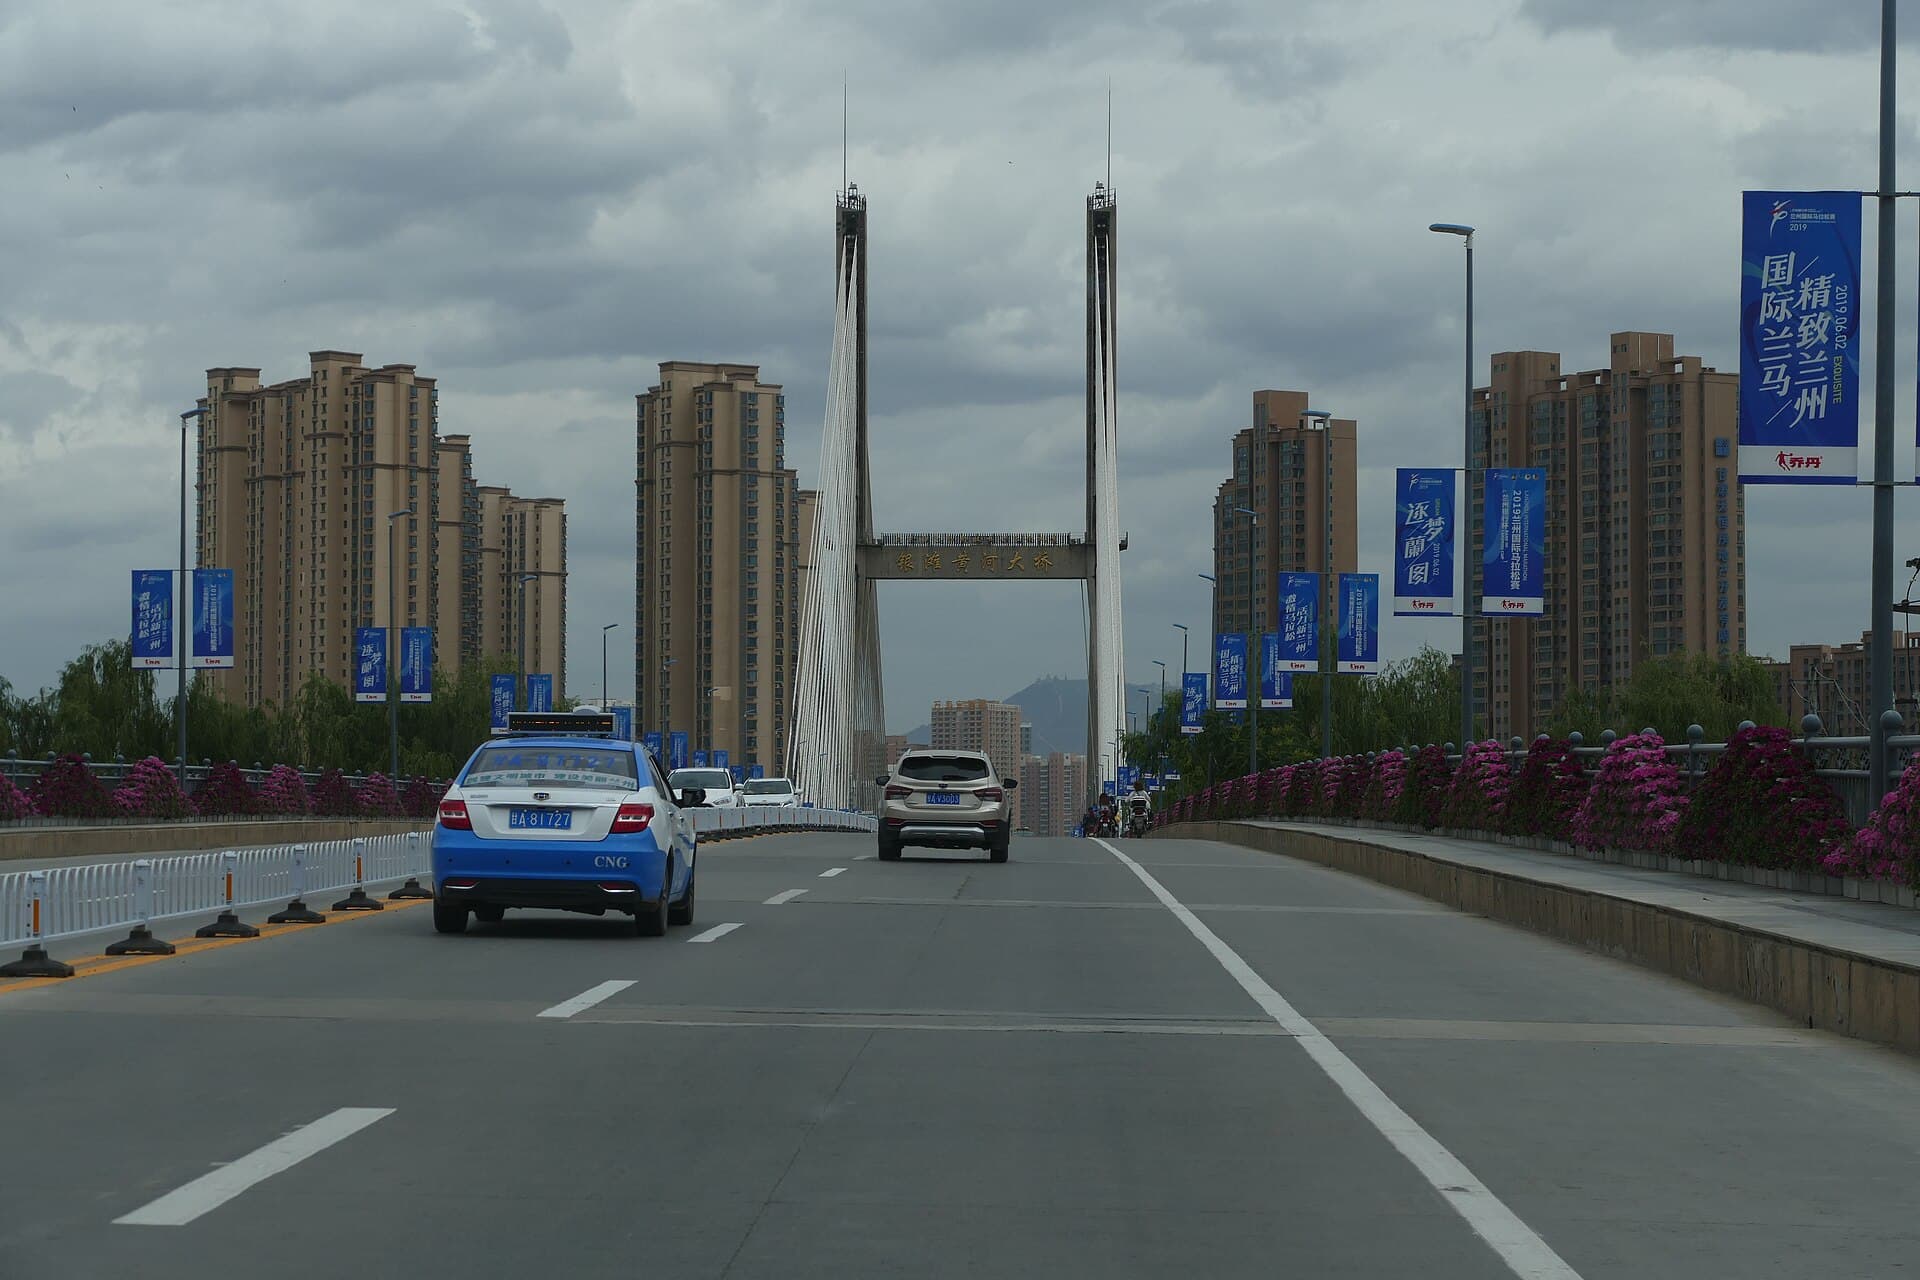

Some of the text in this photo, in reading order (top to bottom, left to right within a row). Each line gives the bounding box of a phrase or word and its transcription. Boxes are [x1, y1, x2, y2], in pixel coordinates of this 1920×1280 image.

[1789, 223, 1808, 231] 2019
[1759, 251, 1796, 397] 国际兰马
[1789, 273, 1836, 428] 精致兰州
[1832, 285, 1848, 404] 2019.06.02 EXQUISITE
[1789, 456, 1822, 470] 乔丹
[594, 855, 628, 868] CNG
